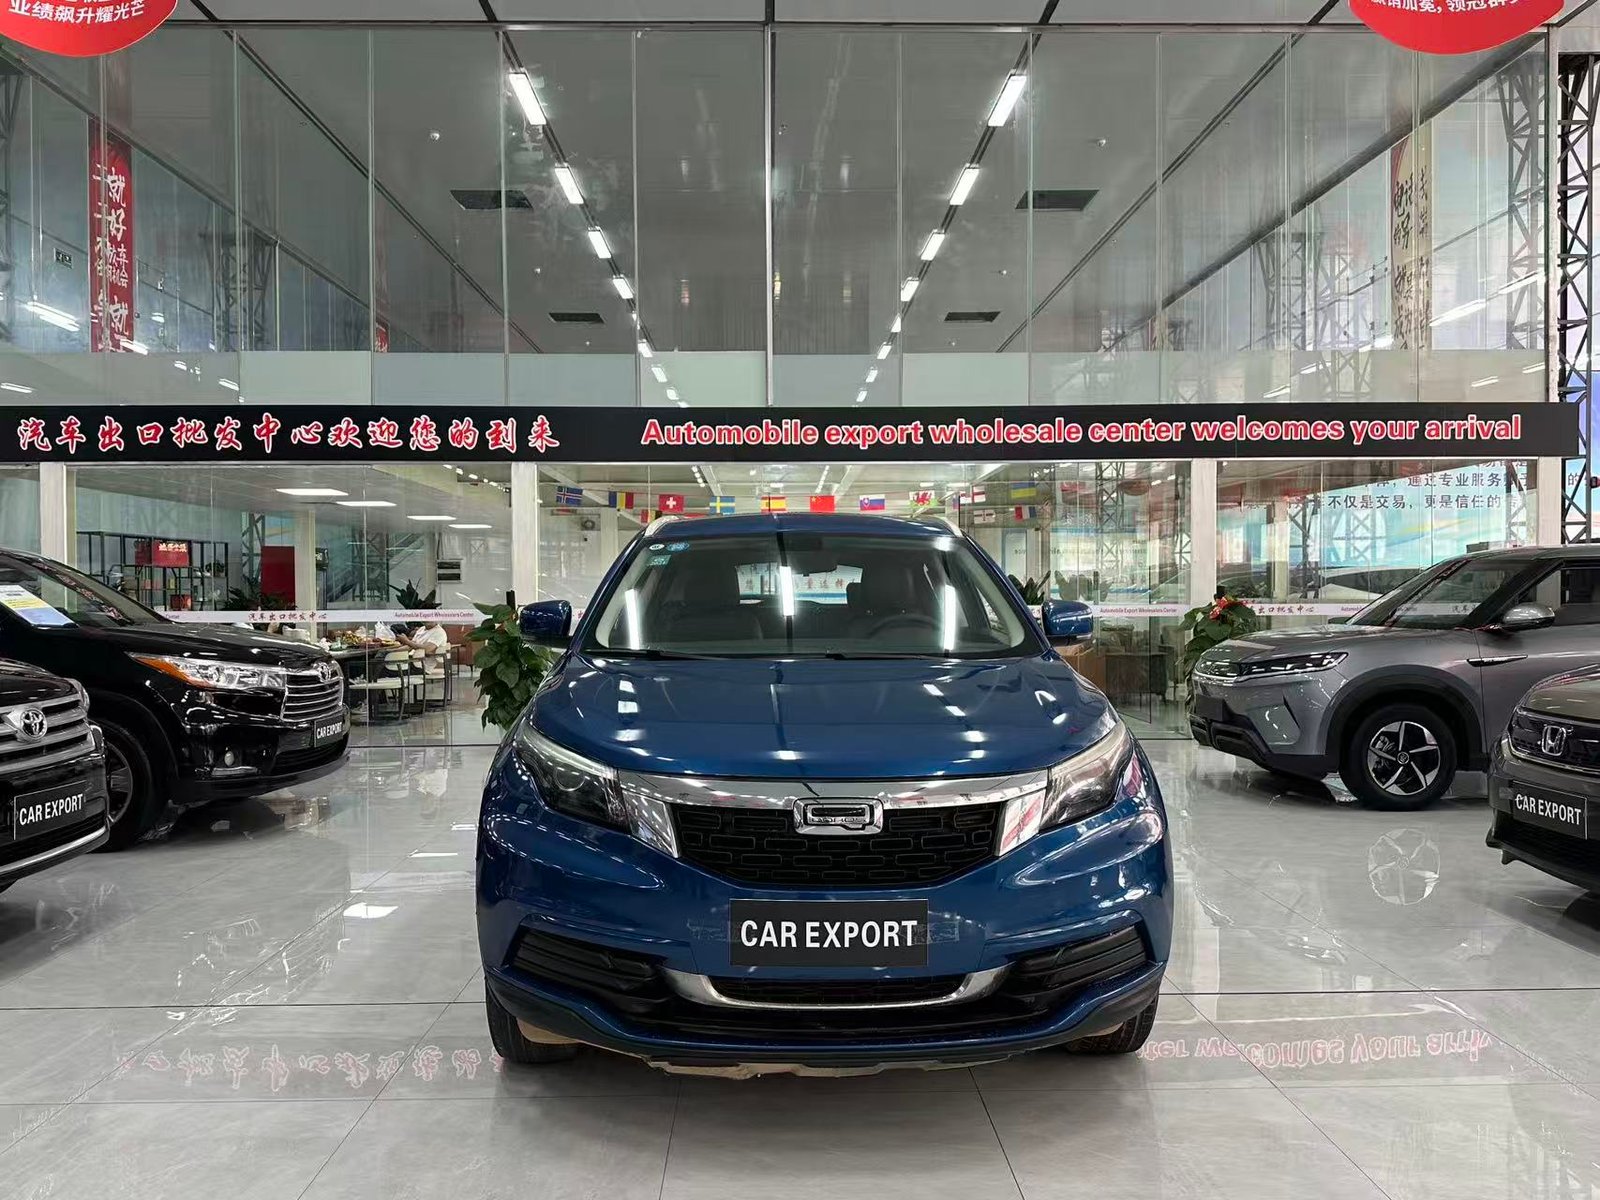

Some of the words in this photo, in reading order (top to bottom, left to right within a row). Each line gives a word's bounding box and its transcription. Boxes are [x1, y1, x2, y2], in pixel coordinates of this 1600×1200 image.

[17, 413, 560, 454] 汽车出口批发中心欢迎您的到来
[641, 418, 819, 445] Automobile
[825, 421, 924, 449] export
[929, 417, 1082, 443] wholesale
[1088, 418, 1186, 442] center
[1192, 415, 1344, 442] welcomes
[1351, 421, 1419, 445] your
[1425, 414, 1521, 440] arrival
[317, 726, 327, 739] CAR
[19, 803, 43, 827] CAR
[44, 793, 84, 820] EXPORT
[1515, 793, 1536, 814] CAR
[1538, 799, 1582, 826] EXPORT
[741, 920, 797, 947] CAR
[805, 921, 917, 948] EXPORT
